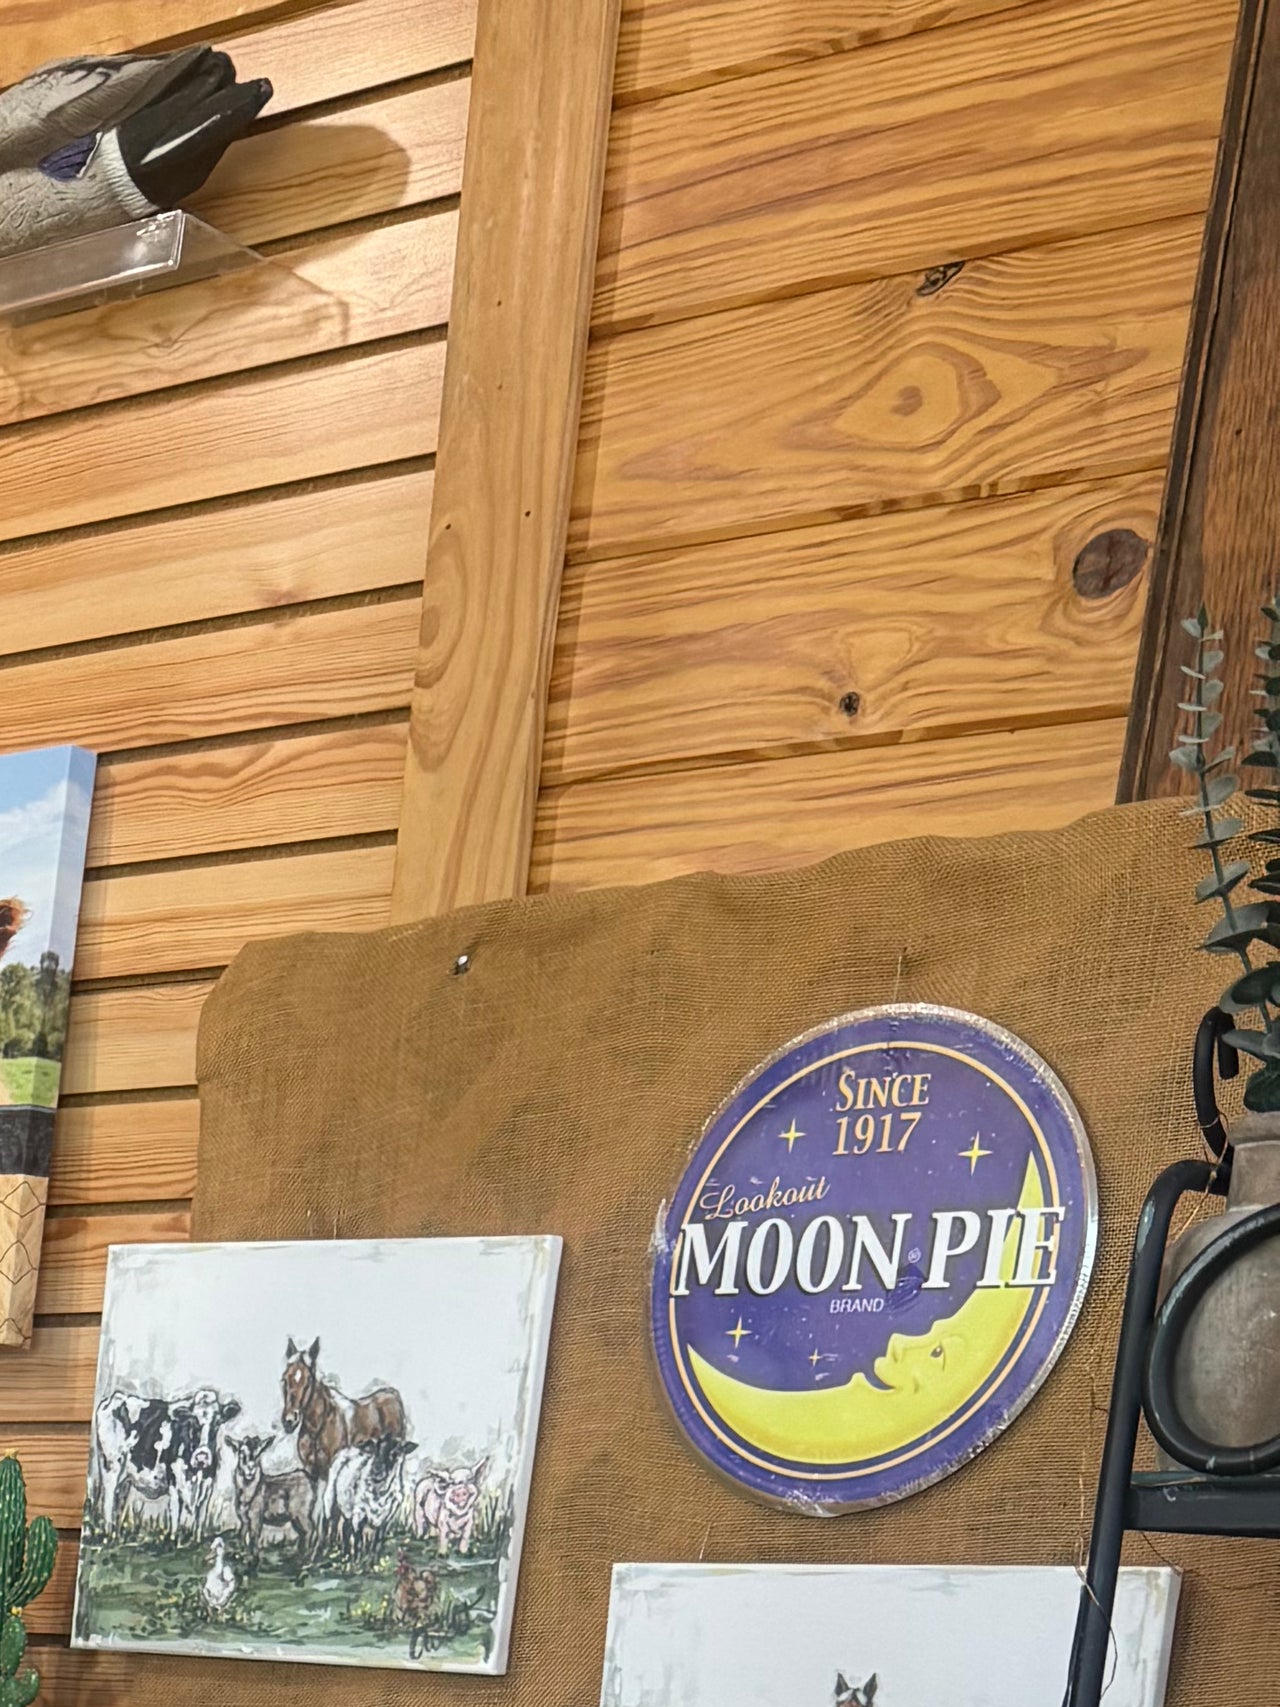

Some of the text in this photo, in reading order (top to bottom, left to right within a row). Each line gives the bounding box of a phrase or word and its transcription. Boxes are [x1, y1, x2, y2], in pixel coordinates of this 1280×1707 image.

[835, 1070, 932, 1112] SINCE
[832, 1112, 922, 1156] 1917
[699, 1176, 831, 1220] Lookout
[673, 1206, 1067, 1296] MOON PIE
[829, 1298, 884, 1314] BRAND
